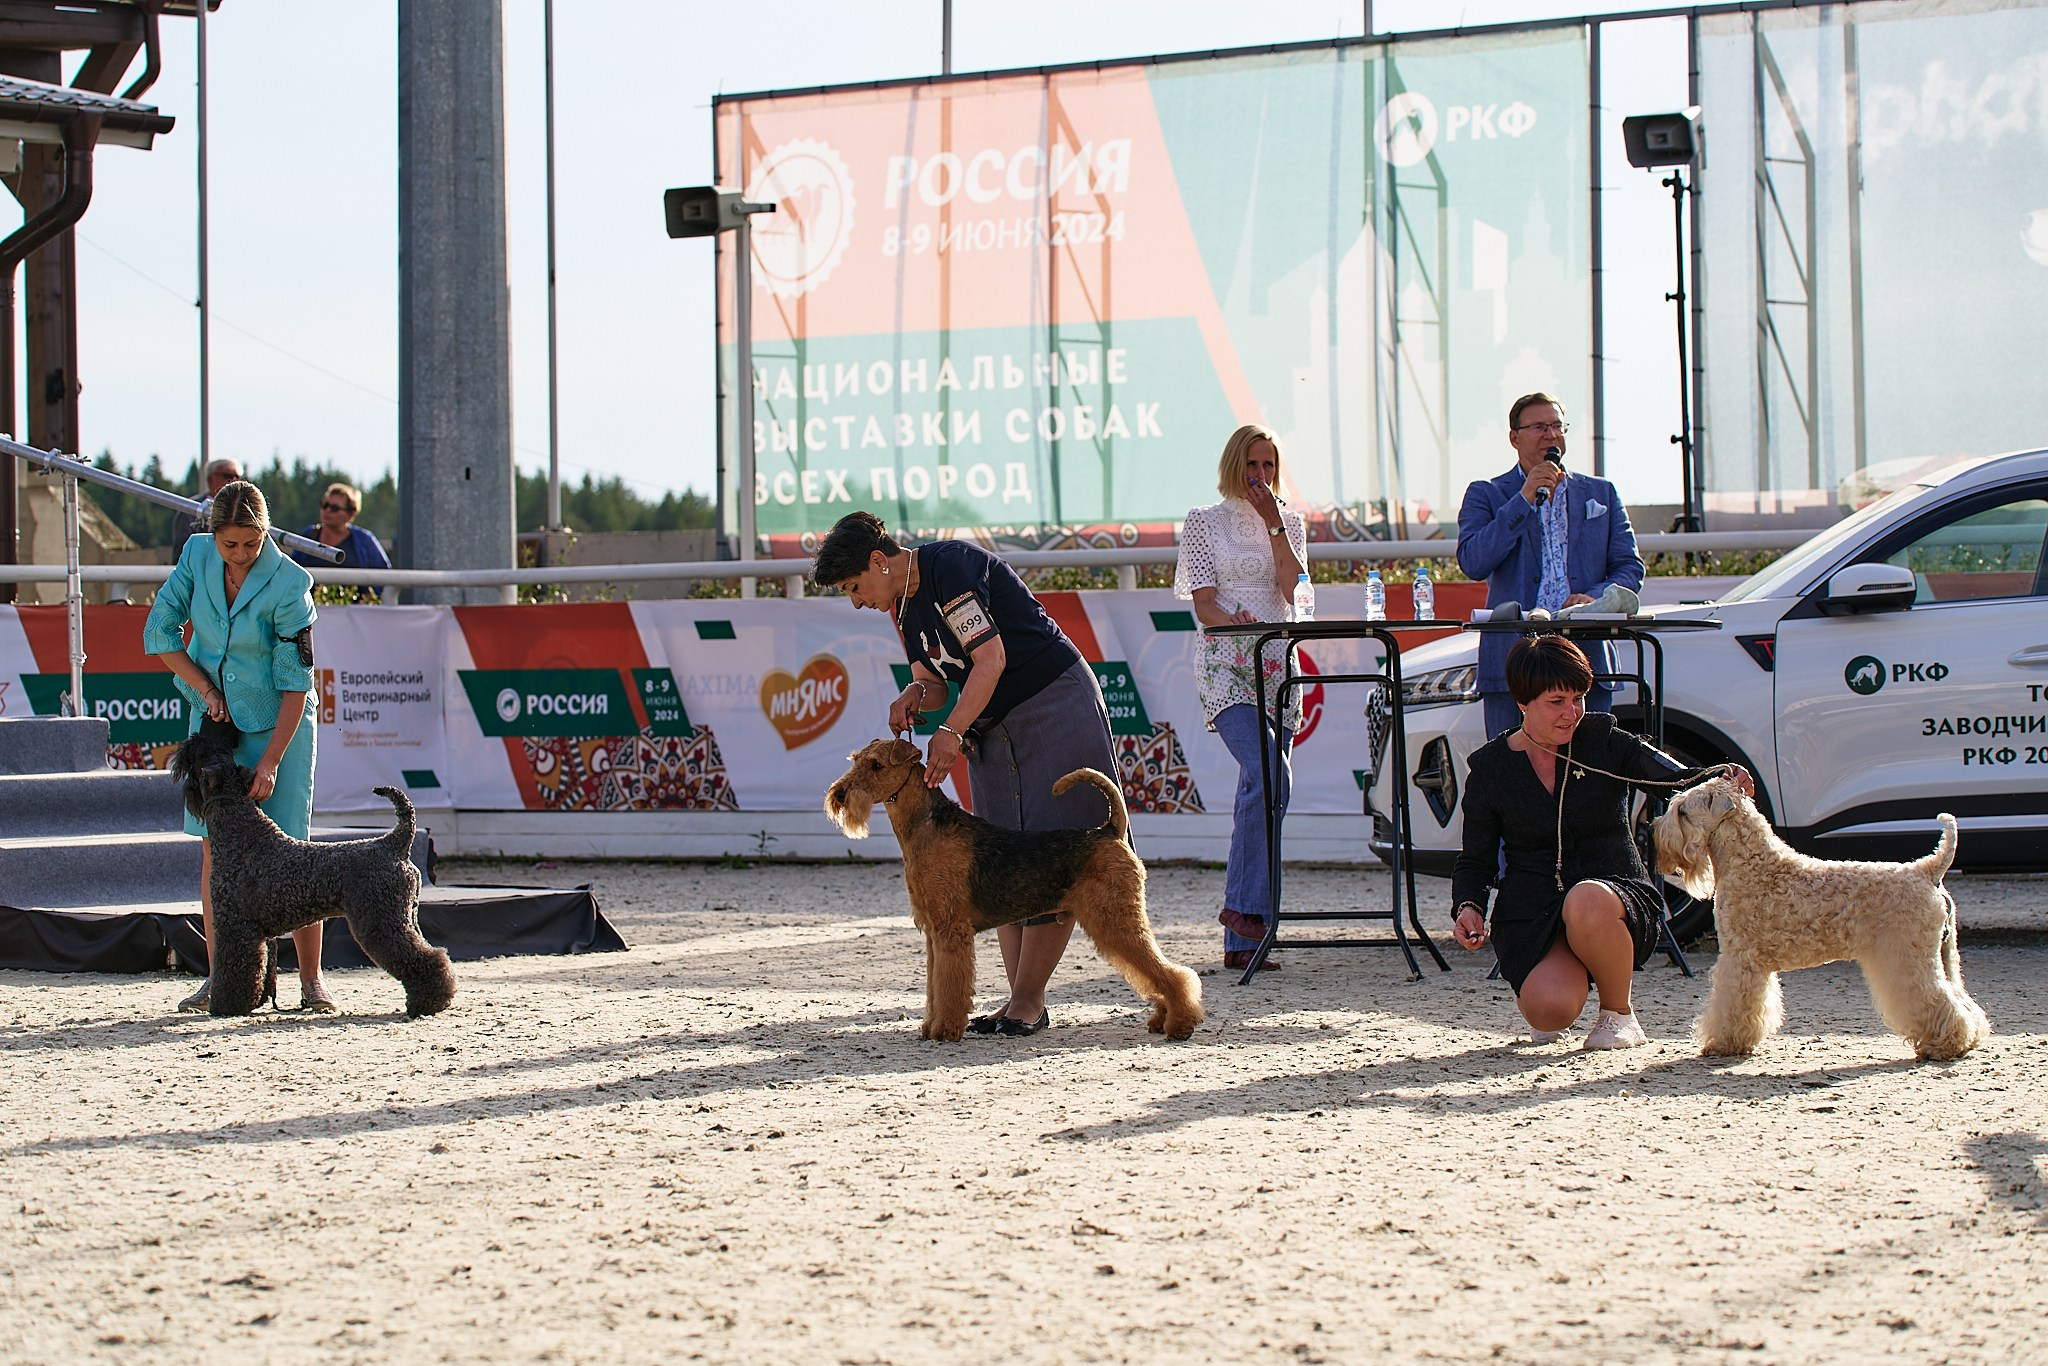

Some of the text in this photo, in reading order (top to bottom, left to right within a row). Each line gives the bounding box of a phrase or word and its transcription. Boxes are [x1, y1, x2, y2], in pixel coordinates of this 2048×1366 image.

[1446, 101, 1538, 142] РКФ
[884, 139, 1132, 209] РОССИЯ
[882, 211, 1126, 256] 8-9 ИЮНЯ 2024
[753, 349, 1128, 405] НАЦИОНАЛЬНЫЕ
[1005, 402, 1163, 443] СОБАК
[755, 462, 1033, 505] ВСЕХ ПОРОД
[956, 614, 982, 636] 1699
[341, 671, 424, 686] Европейский
[1892, 663, 1949, 682] РКФ
[342, 689, 432, 704] Ветеринарный
[527, 694, 608, 715] РОССИЯ
[645, 696, 678, 706] ИЮНЯ
[95, 698, 181, 720] РОССИЯ
[343, 708, 379, 723] Центр
[654, 710, 679, 721] 2024
[1109, 706, 1136, 718] 2024
[1922, 715, 2046, 738] ЗАВОДЧИ
[1963, 747, 2017, 765] РКФ
